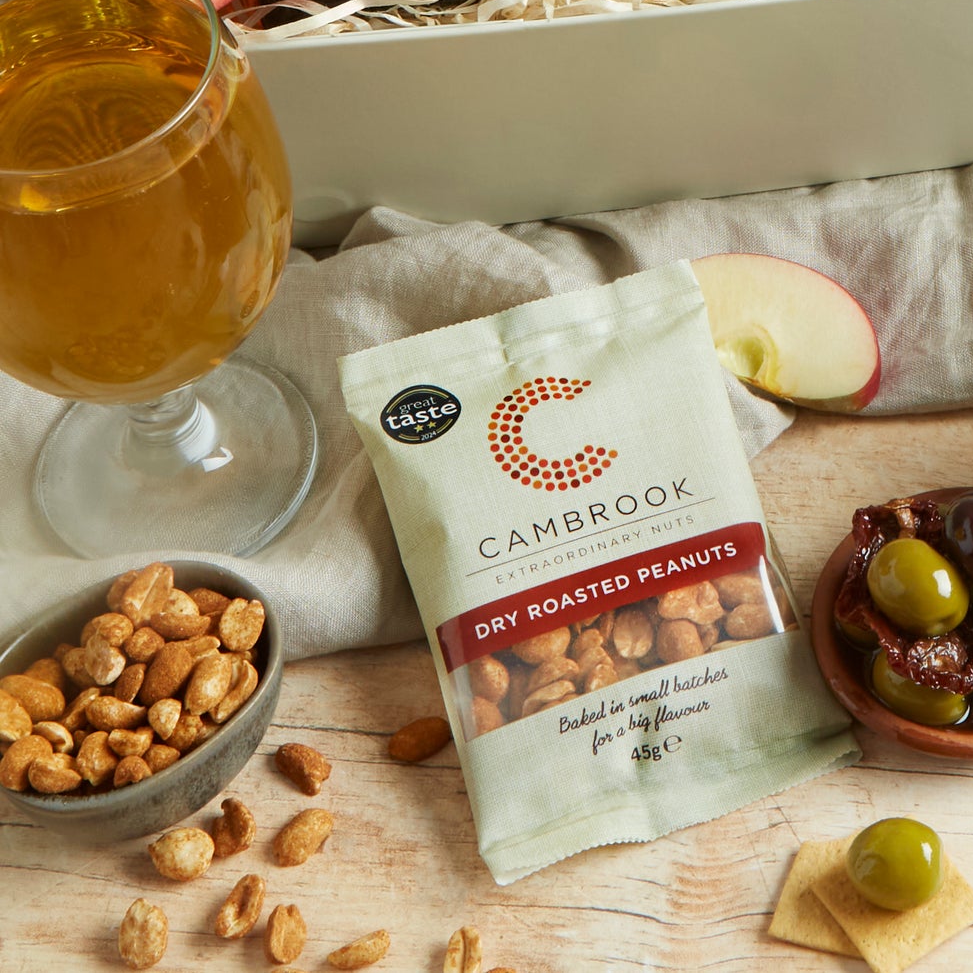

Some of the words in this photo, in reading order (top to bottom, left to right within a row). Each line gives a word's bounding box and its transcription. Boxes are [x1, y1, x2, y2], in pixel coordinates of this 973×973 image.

[386, 402, 458, 429] taste
[399, 396, 438, 415] great
[420, 431, 437, 441] 2024
[478, 477, 695, 559] CAMBROOK
[495, 530, 643, 585] EXTRAORDINARY
[651, 514, 696, 535] NUTS
[474, 611, 520, 640] DRY
[527, 574, 631, 621] ROASTED
[637, 542, 738, 583] PEANUTS
[559, 701, 607, 734] Baked
[609, 700, 625, 715] in
[628, 678, 670, 708] small
[672, 667, 729, 693] batches
[592, 729, 613, 755] for
[616, 726, 626, 738] a
[628, 714, 651, 732] big
[654, 699, 710, 731] flavour
